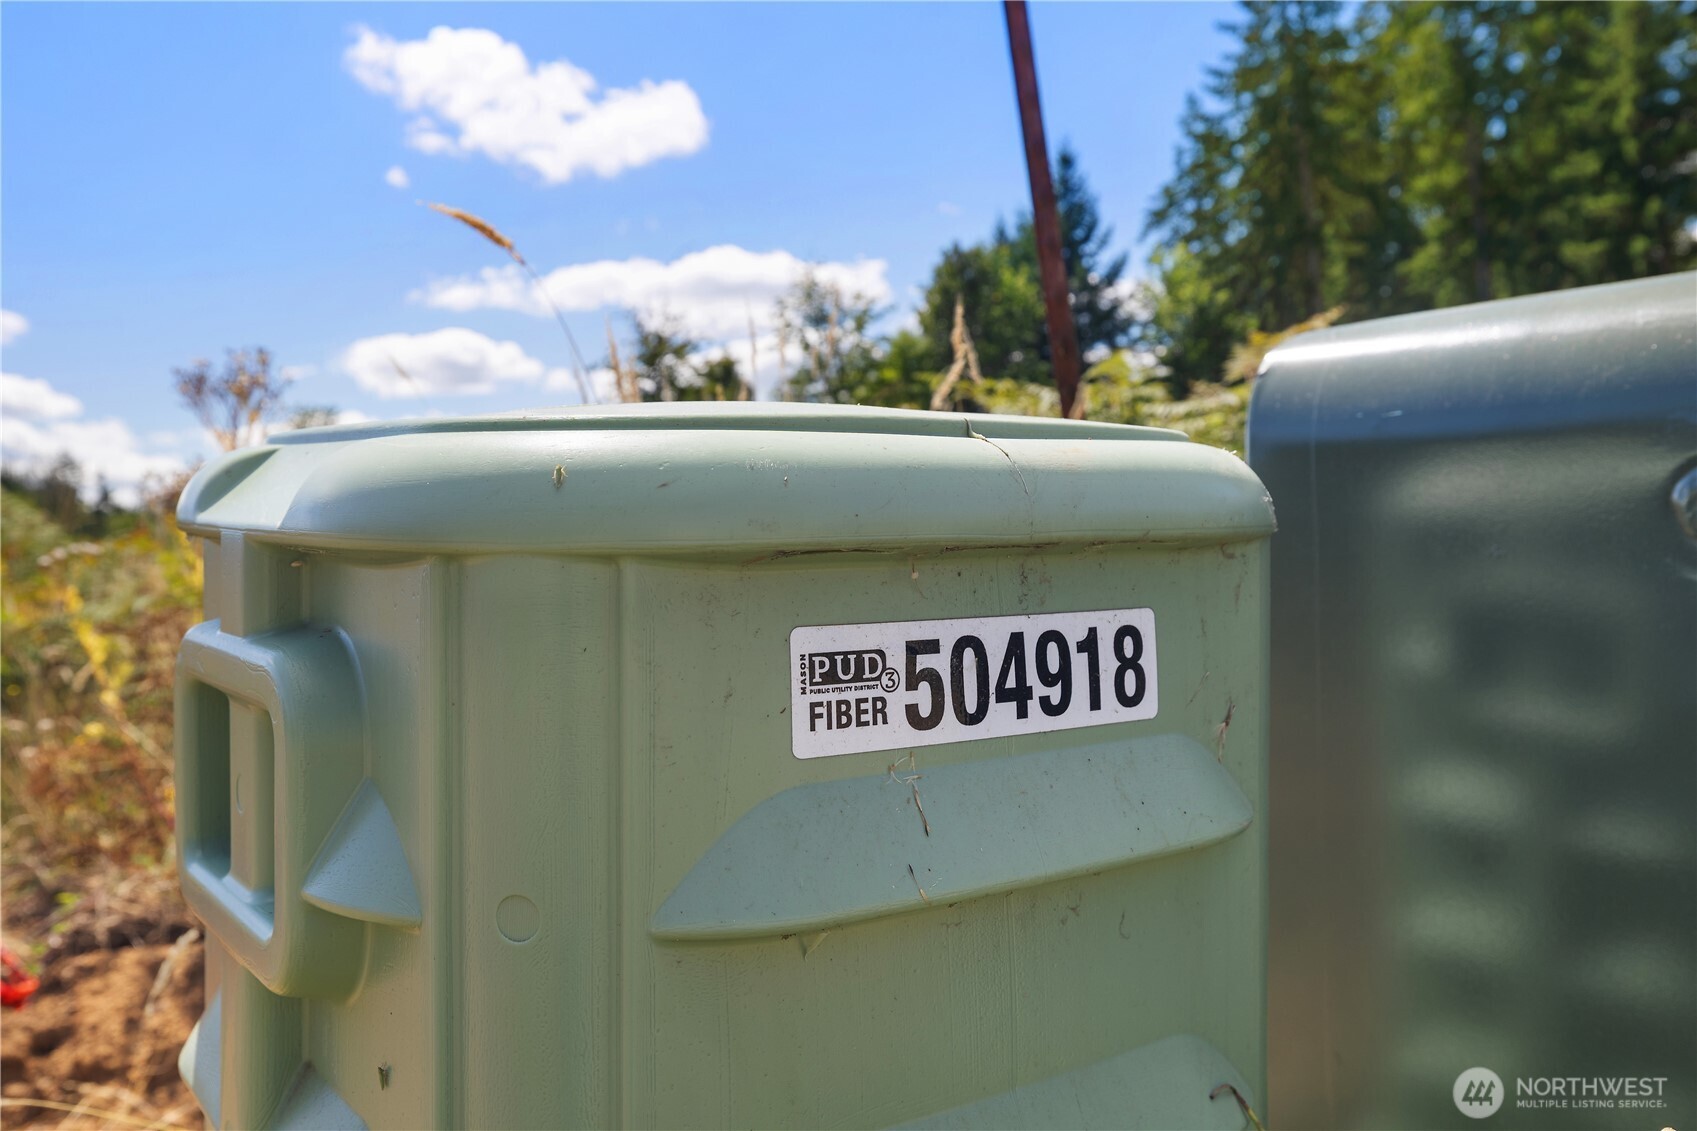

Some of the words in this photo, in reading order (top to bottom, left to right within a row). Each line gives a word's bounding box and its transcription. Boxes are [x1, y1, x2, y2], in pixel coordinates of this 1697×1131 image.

[812, 653, 883, 682] PUD
[904, 624, 1146, 731] 504918
[809, 687, 830, 695] PUBLIC
[809, 696, 889, 732] FIBER
